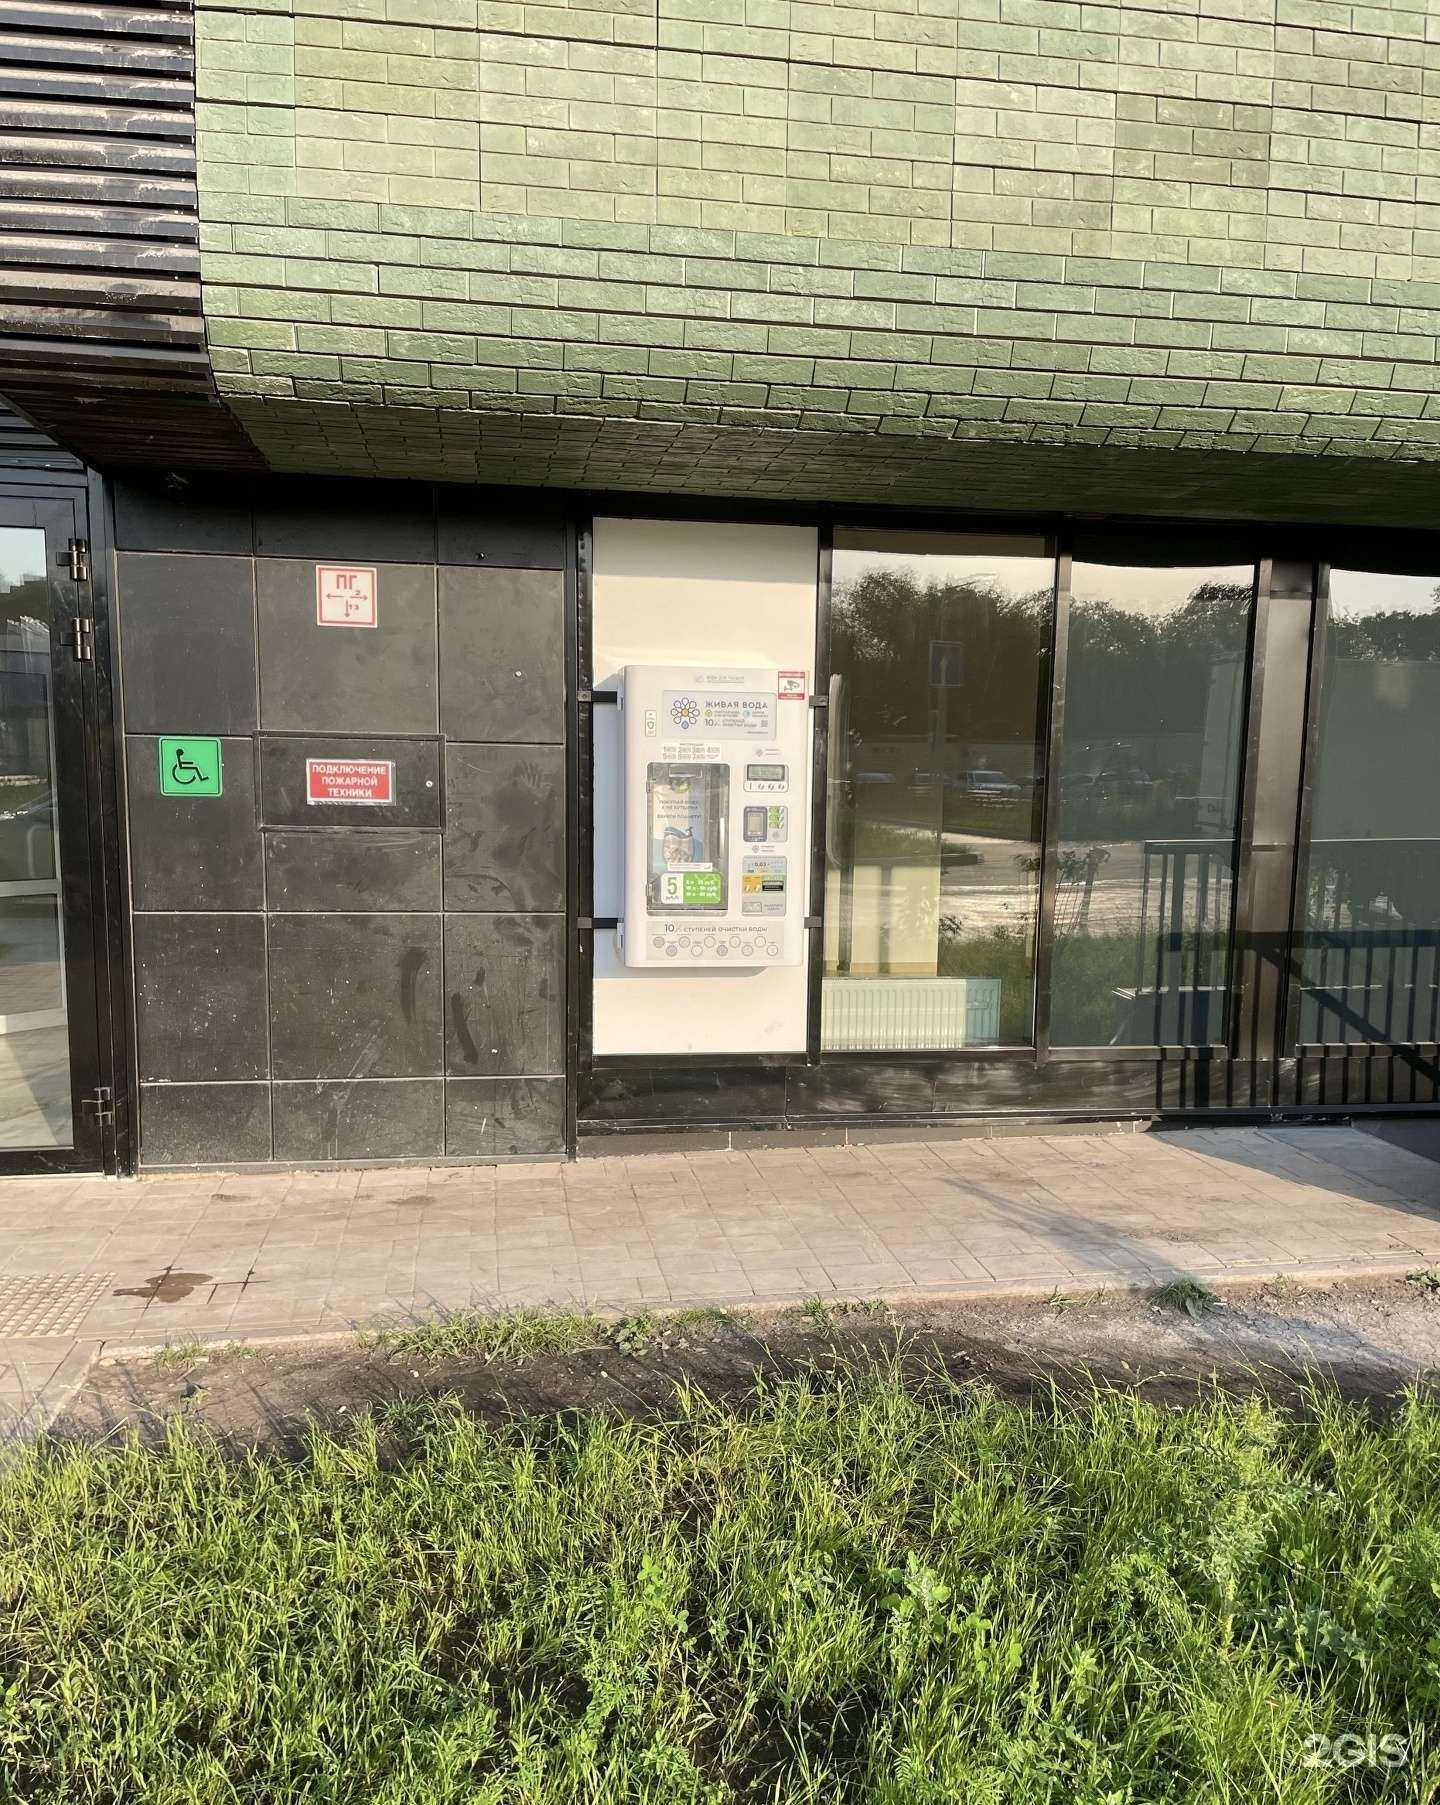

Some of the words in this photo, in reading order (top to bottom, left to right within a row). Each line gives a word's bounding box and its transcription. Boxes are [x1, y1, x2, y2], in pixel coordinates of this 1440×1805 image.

[336, 574, 357, 589] ПГ
[705, 701, 739, 709] ЖИВАЯ
[742, 701, 768, 709] ВОДА
[312, 764, 387, 775] ПОДКЛЮЧЕНИЕ
[322, 775, 378, 787] ПОЖАРНОЙ
[328, 787, 372, 797] ТЕХНИКИ
[667, 877, 678, 895] 5
[665, 923, 675, 932] 10
